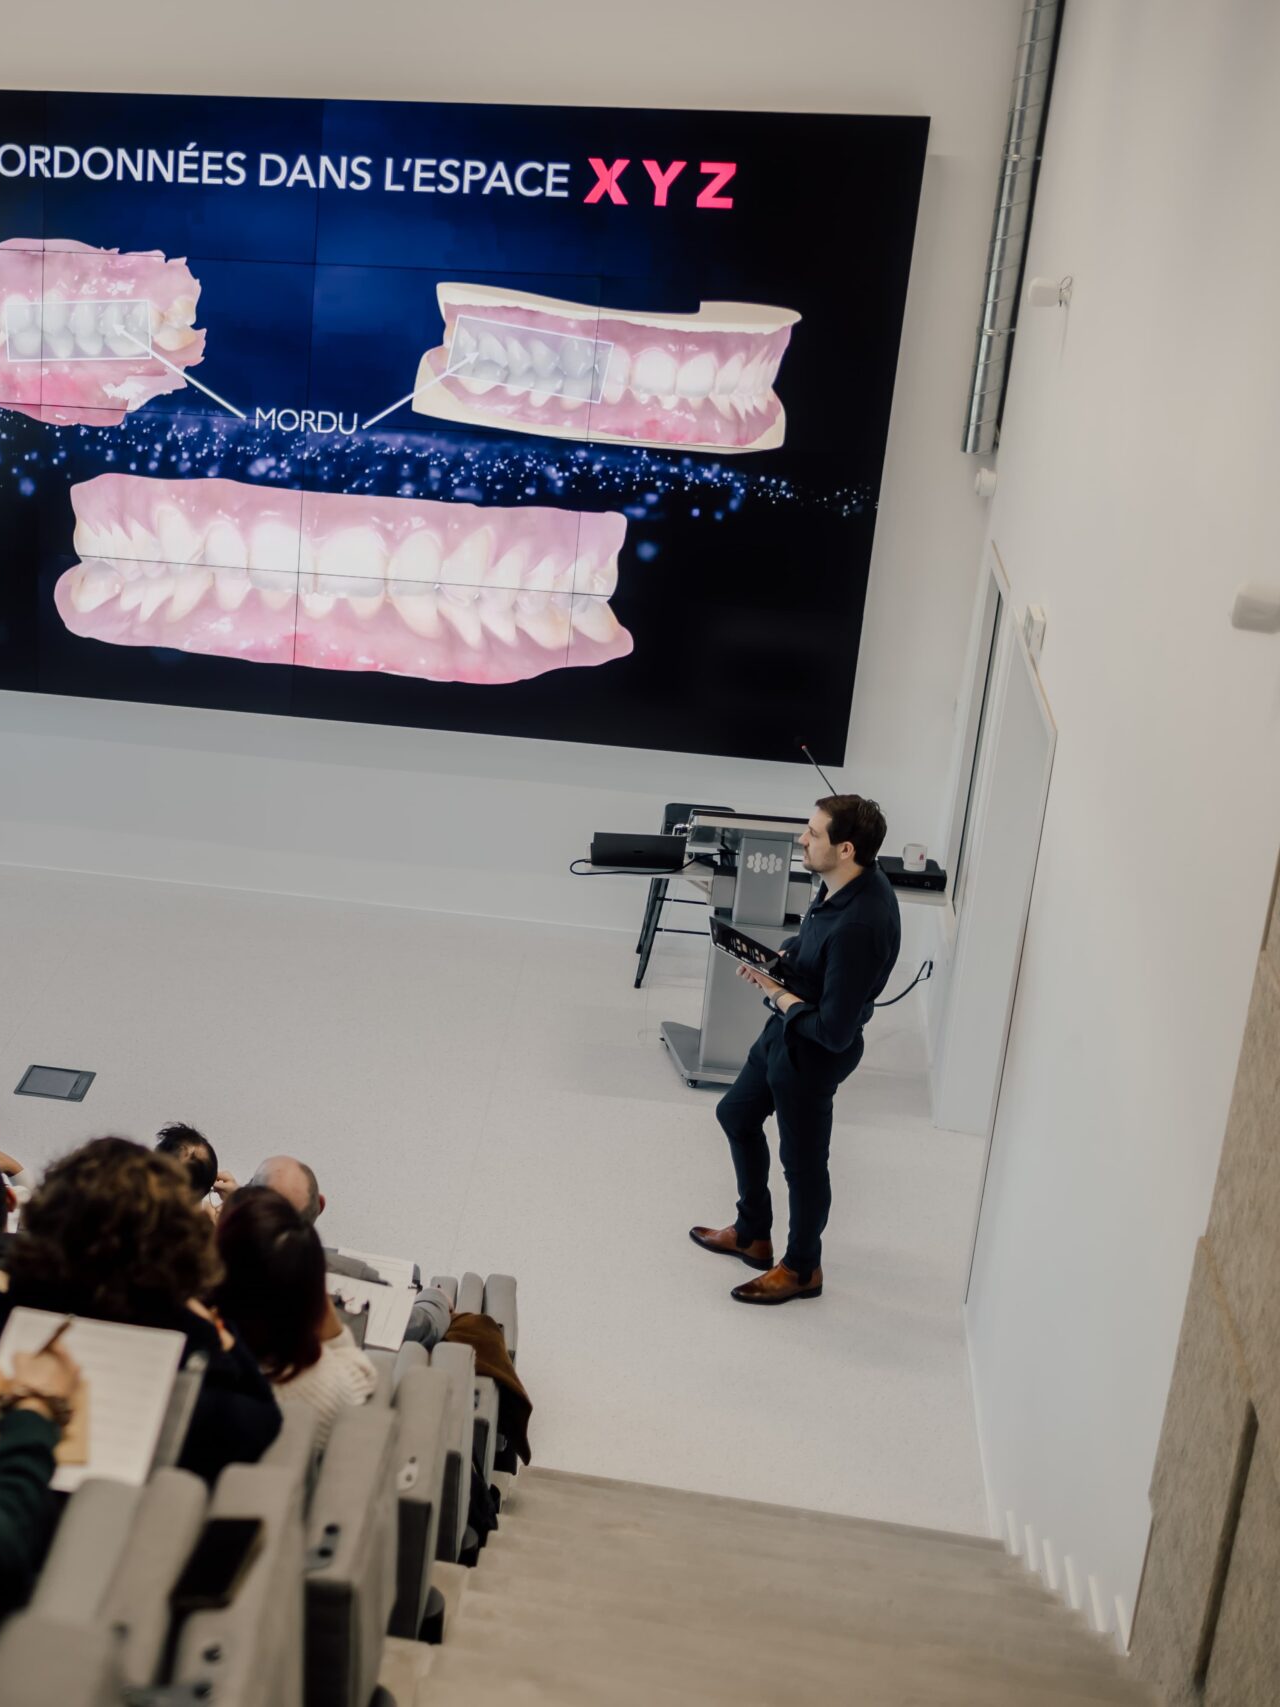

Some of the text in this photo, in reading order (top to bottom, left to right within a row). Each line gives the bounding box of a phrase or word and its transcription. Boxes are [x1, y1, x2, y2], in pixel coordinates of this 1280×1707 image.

[258, 152, 373, 191] DANS
[384, 157, 571, 198] L'ESPACE
[583, 157, 631, 206] X
[642, 159, 688, 207] Y
[695, 162, 738, 209] Z
[255, 406, 359, 436] MORDU
